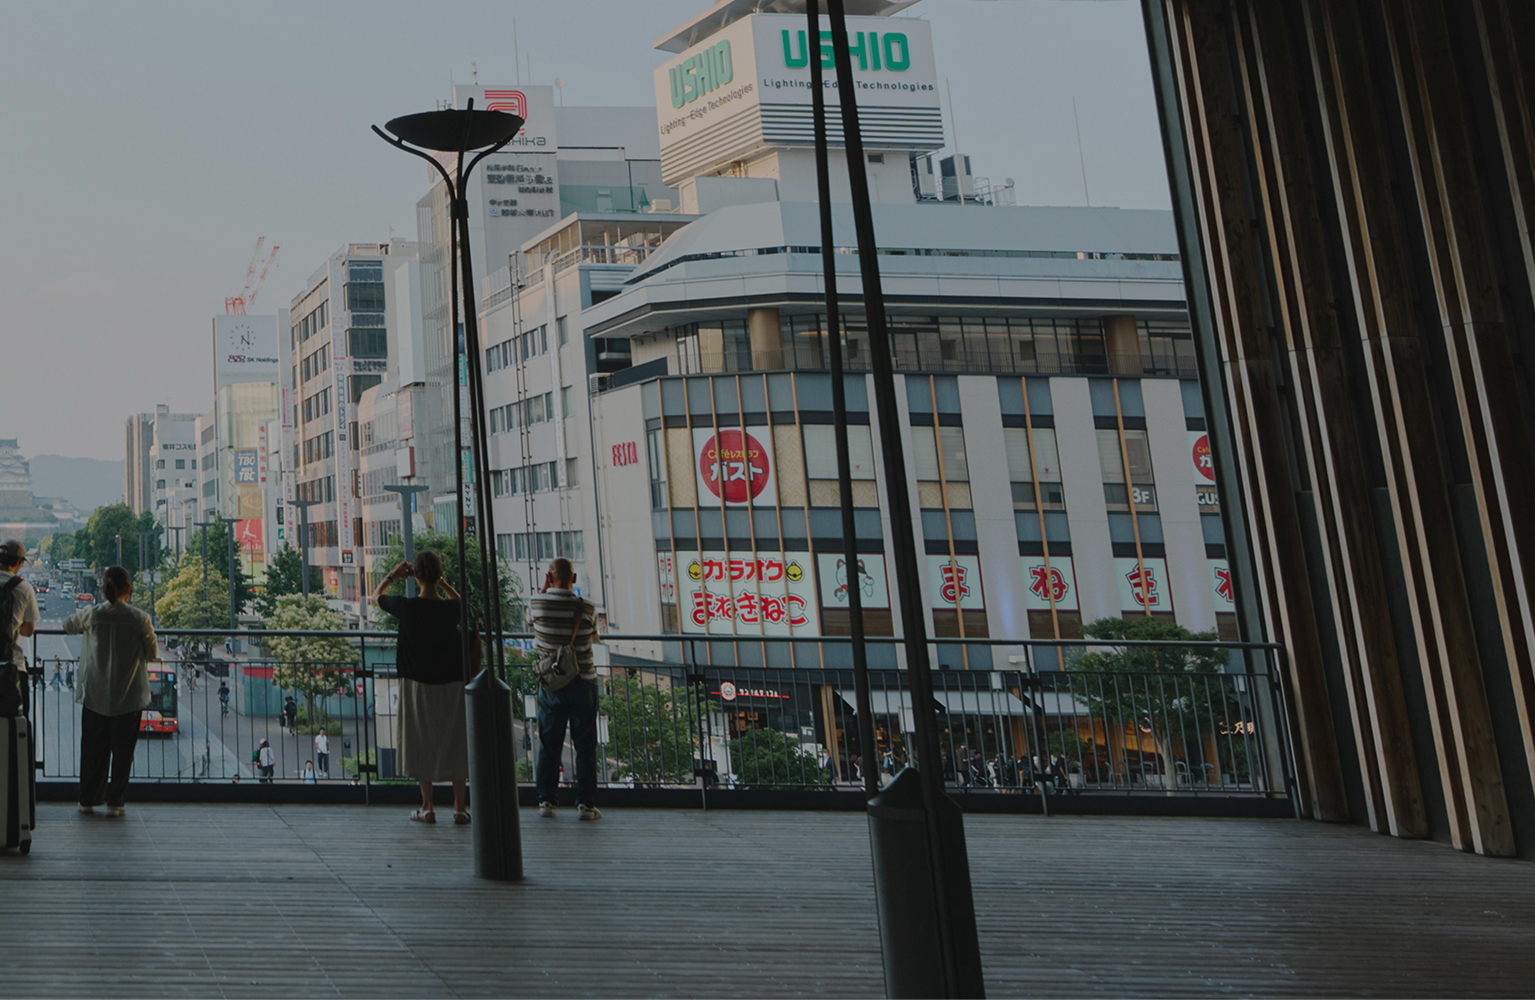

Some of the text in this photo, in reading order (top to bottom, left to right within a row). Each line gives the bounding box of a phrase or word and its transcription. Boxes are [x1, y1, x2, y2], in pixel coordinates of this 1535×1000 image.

[669, 39, 733, 108] USHIO
[717, 83, 753, 111] Technologies
[856, 81, 934, 92] Technologies
[238, 456, 255, 466] TBC
[612, 441, 638, 467] FESTA
[238, 472, 255, 481] TBC
[710, 461, 763, 482] ガスト
[1132, 488, 1150, 503] 3F
[692, 591, 806, 625] まねきねこ
